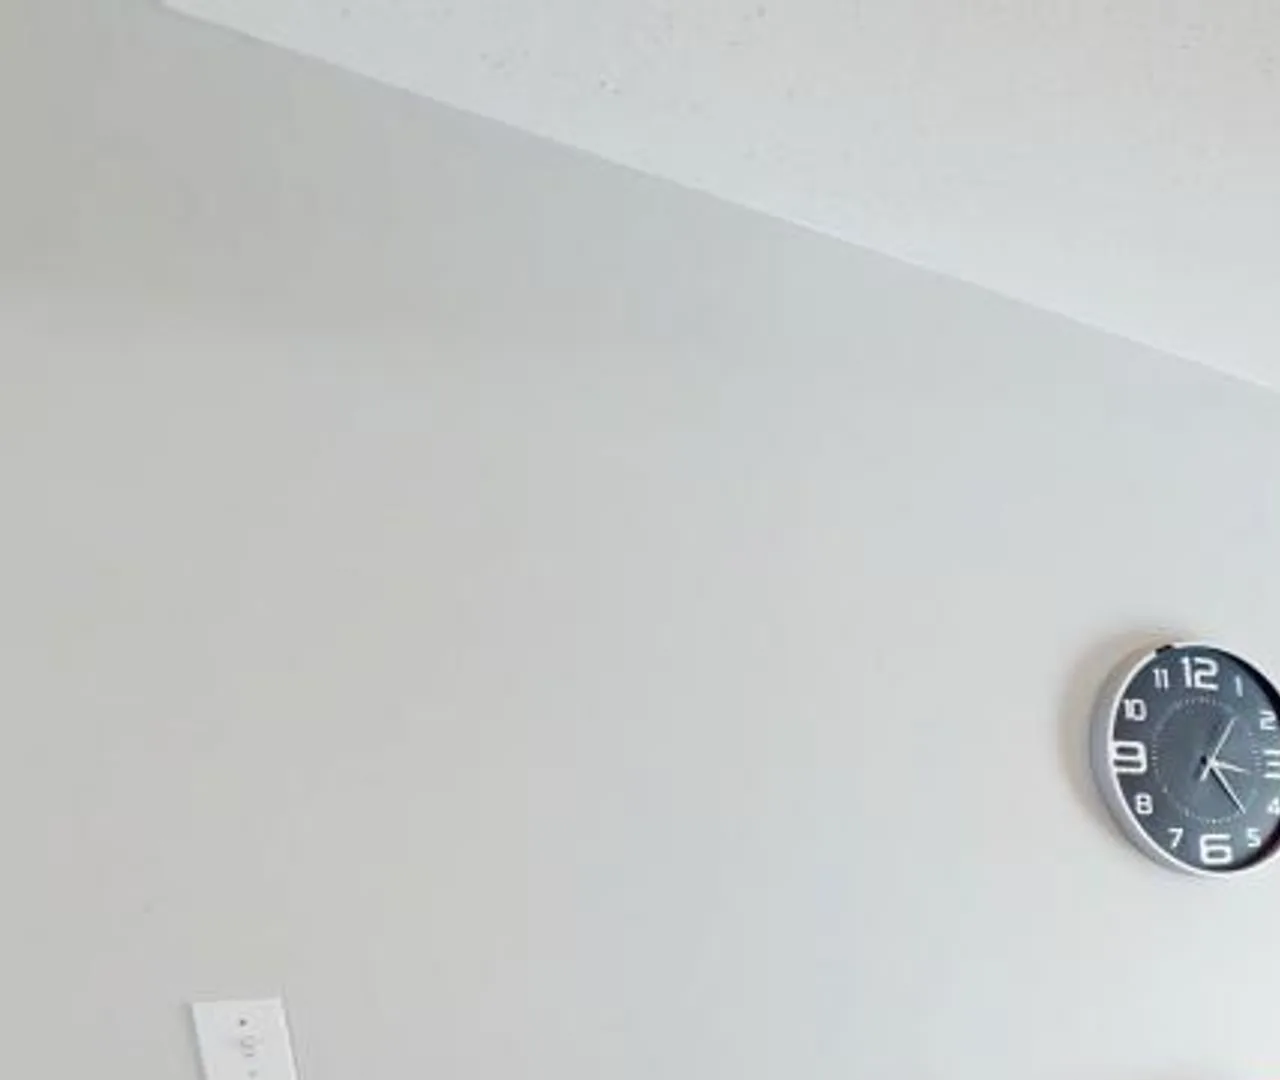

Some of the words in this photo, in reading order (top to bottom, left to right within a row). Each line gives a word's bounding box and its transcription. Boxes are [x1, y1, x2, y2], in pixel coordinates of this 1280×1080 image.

[1153, 668, 1170, 690] 11
[1180, 656, 1220, 691] 12
[1234, 675, 1244, 697] 1
[1123, 699, 1147, 722] 10
[1259, 710, 1276, 730] 2
[1135, 794, 1153, 815] 8
[1267, 797, 1280, 816] 4
[1167, 828, 1184, 848] 7
[1200, 833, 1233, 864] 6
[1246, 828, 1262, 848] 5
